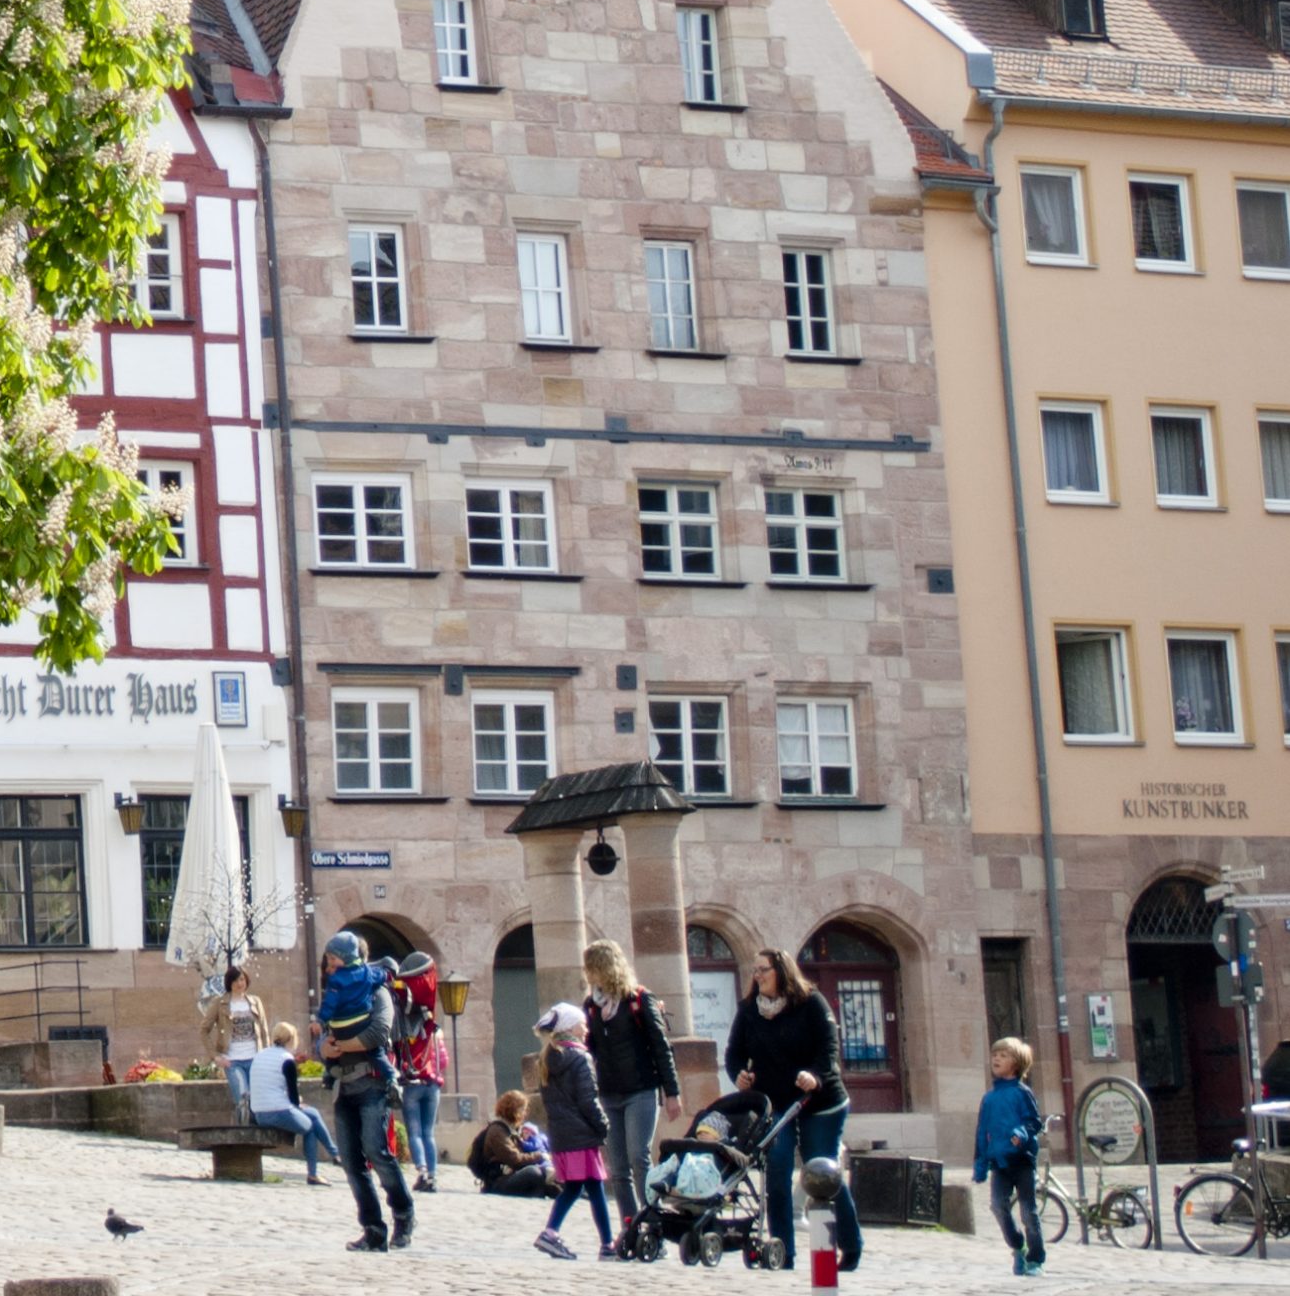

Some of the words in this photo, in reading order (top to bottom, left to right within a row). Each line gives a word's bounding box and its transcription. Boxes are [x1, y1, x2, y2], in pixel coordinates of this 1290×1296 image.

[126, 672, 197, 724] Haus
[1139, 782, 1227, 796] HISTORISCHER
[1122, 799, 1249, 819] KUNSTBUNKER
[312, 852, 336, 865] Obere
